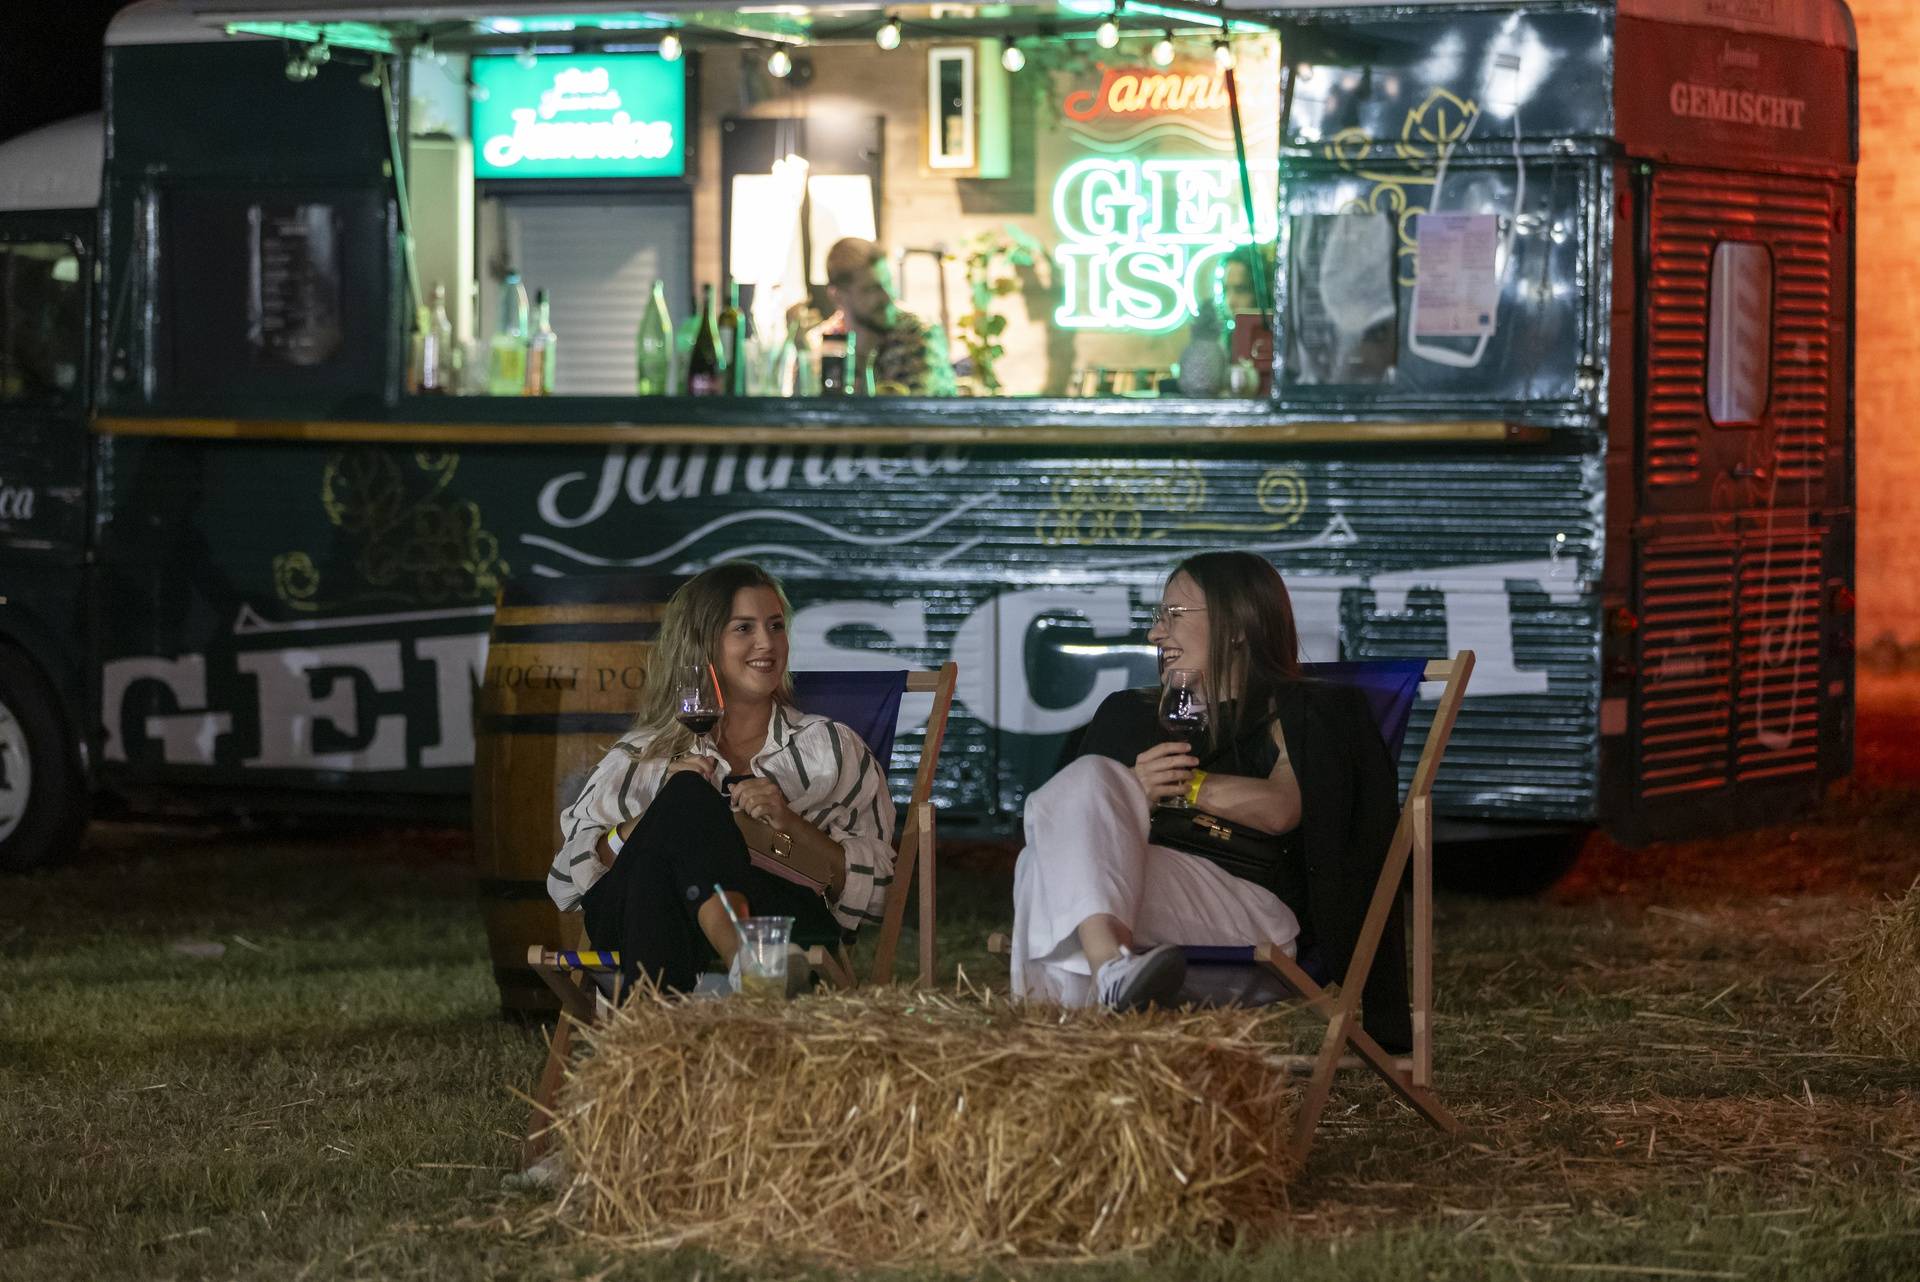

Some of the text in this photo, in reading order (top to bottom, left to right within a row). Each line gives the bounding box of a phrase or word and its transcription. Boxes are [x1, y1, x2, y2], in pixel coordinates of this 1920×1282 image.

[1063, 62, 1234, 122] Jamni
[1670, 81, 1805, 130] GEMISCHT
[598, 667, 647, 692] PO
